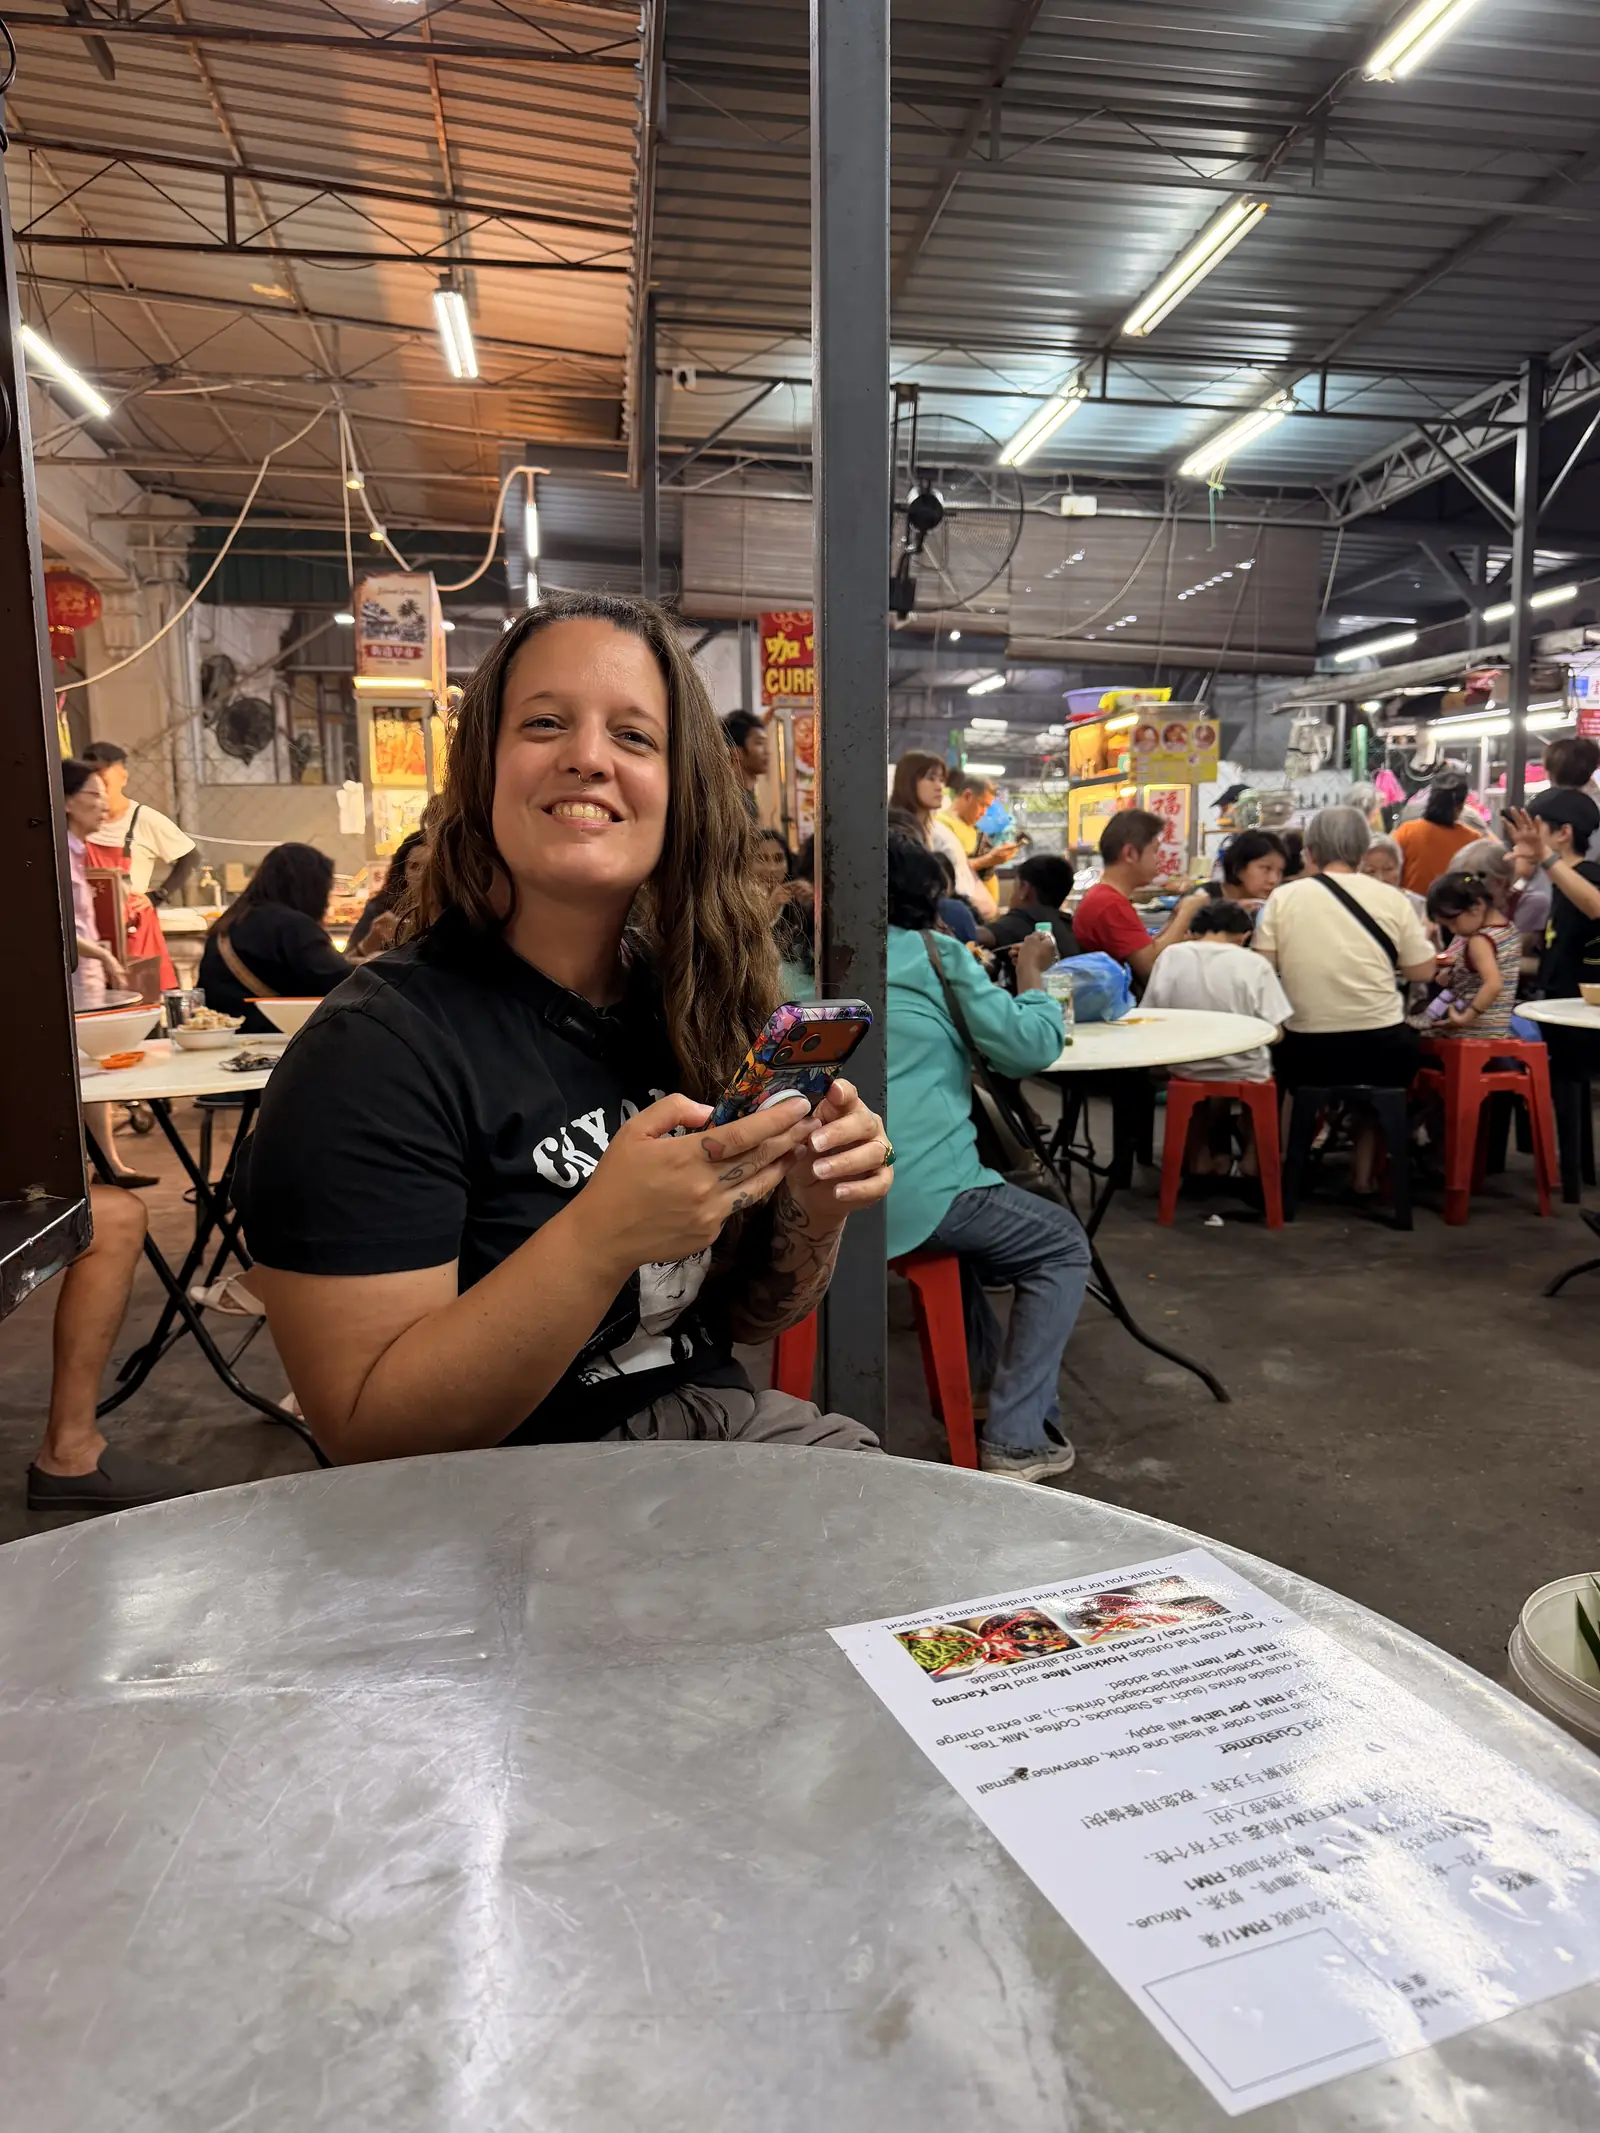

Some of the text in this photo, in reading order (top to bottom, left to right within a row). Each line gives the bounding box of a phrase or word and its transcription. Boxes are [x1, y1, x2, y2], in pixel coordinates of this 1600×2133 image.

[765, 668, 814, 695] CURR
[1103, 1574, 1127, 1585] you
[1126, 1567, 1166, 1580] Thank
[1059, 1584, 1087, 1595] your
[1087, 1581, 1105, 1589] for
[1031, 1591, 1060, 1601] kind
[945, 1596, 1031, 1617] understanding
[880, 1617, 932, 1630] support.
[1161, 1627, 1190, 1639] Ice)
[1079, 1645, 1106, 1656] are
[1106, 1635, 1155, 1652] Cendol
[1246, 1641, 1278, 1655] RM1
[930, 1616, 1283, 1706] 3. Kindly note that outside Hokkien Mee and Ice Kacang
[977, 1645, 1022, 1664] NO
[1058, 1650, 1083, 1663] not
[1223, 1647, 1246, 1660] per
[1008, 1656, 1060, 1676] allowed
[1168, 1663, 1192, 1675] will
[1191, 1655, 1224, 1668] item
[964, 1669, 1011, 1684] inside.
[1150, 1668, 1171, 1678] be
[1247, 1663, 1292, 1680] outside
[1104, 1673, 1150, 1690] added.
[1207, 1675, 1247, 1690] drinks
[1169, 1684, 1208, 1700] (such
[1227, 1699, 1252, 1713] per
[1252, 1693, 1286, 1707] RM1
[1023, 1712, 1042, 1723] an
[1079, 1700, 1153, 1721] Starbucks,
[1189, 1708, 1228, 1723] table
[1255, 1705, 1290, 1720] must
[985, 1718, 1022, 1732] extra
[1028, 1717, 1081, 1733] Coffee,
[1165, 1718, 1190, 1730] will
[1203, 1724, 1219, 1734] at
[1220, 1714, 1256, 1729] order
[935, 1727, 984, 1746] charge
[997, 1730, 1029, 1743] Milk
[1124, 1723, 1166, 1738] apply.
[1169, 1728, 1206, 1743] least
[964, 1739, 1000, 1751] Tea,
[1141, 1737, 1169, 1749] one
[1214, 1724, 1302, 1754] Customer
[1099, 1744, 1140, 1759] drink,
[1030, 1754, 1100, 1777] otherwise
[975, 1775, 1017, 1794] small
[1183, 1871, 1227, 1891] RM1
